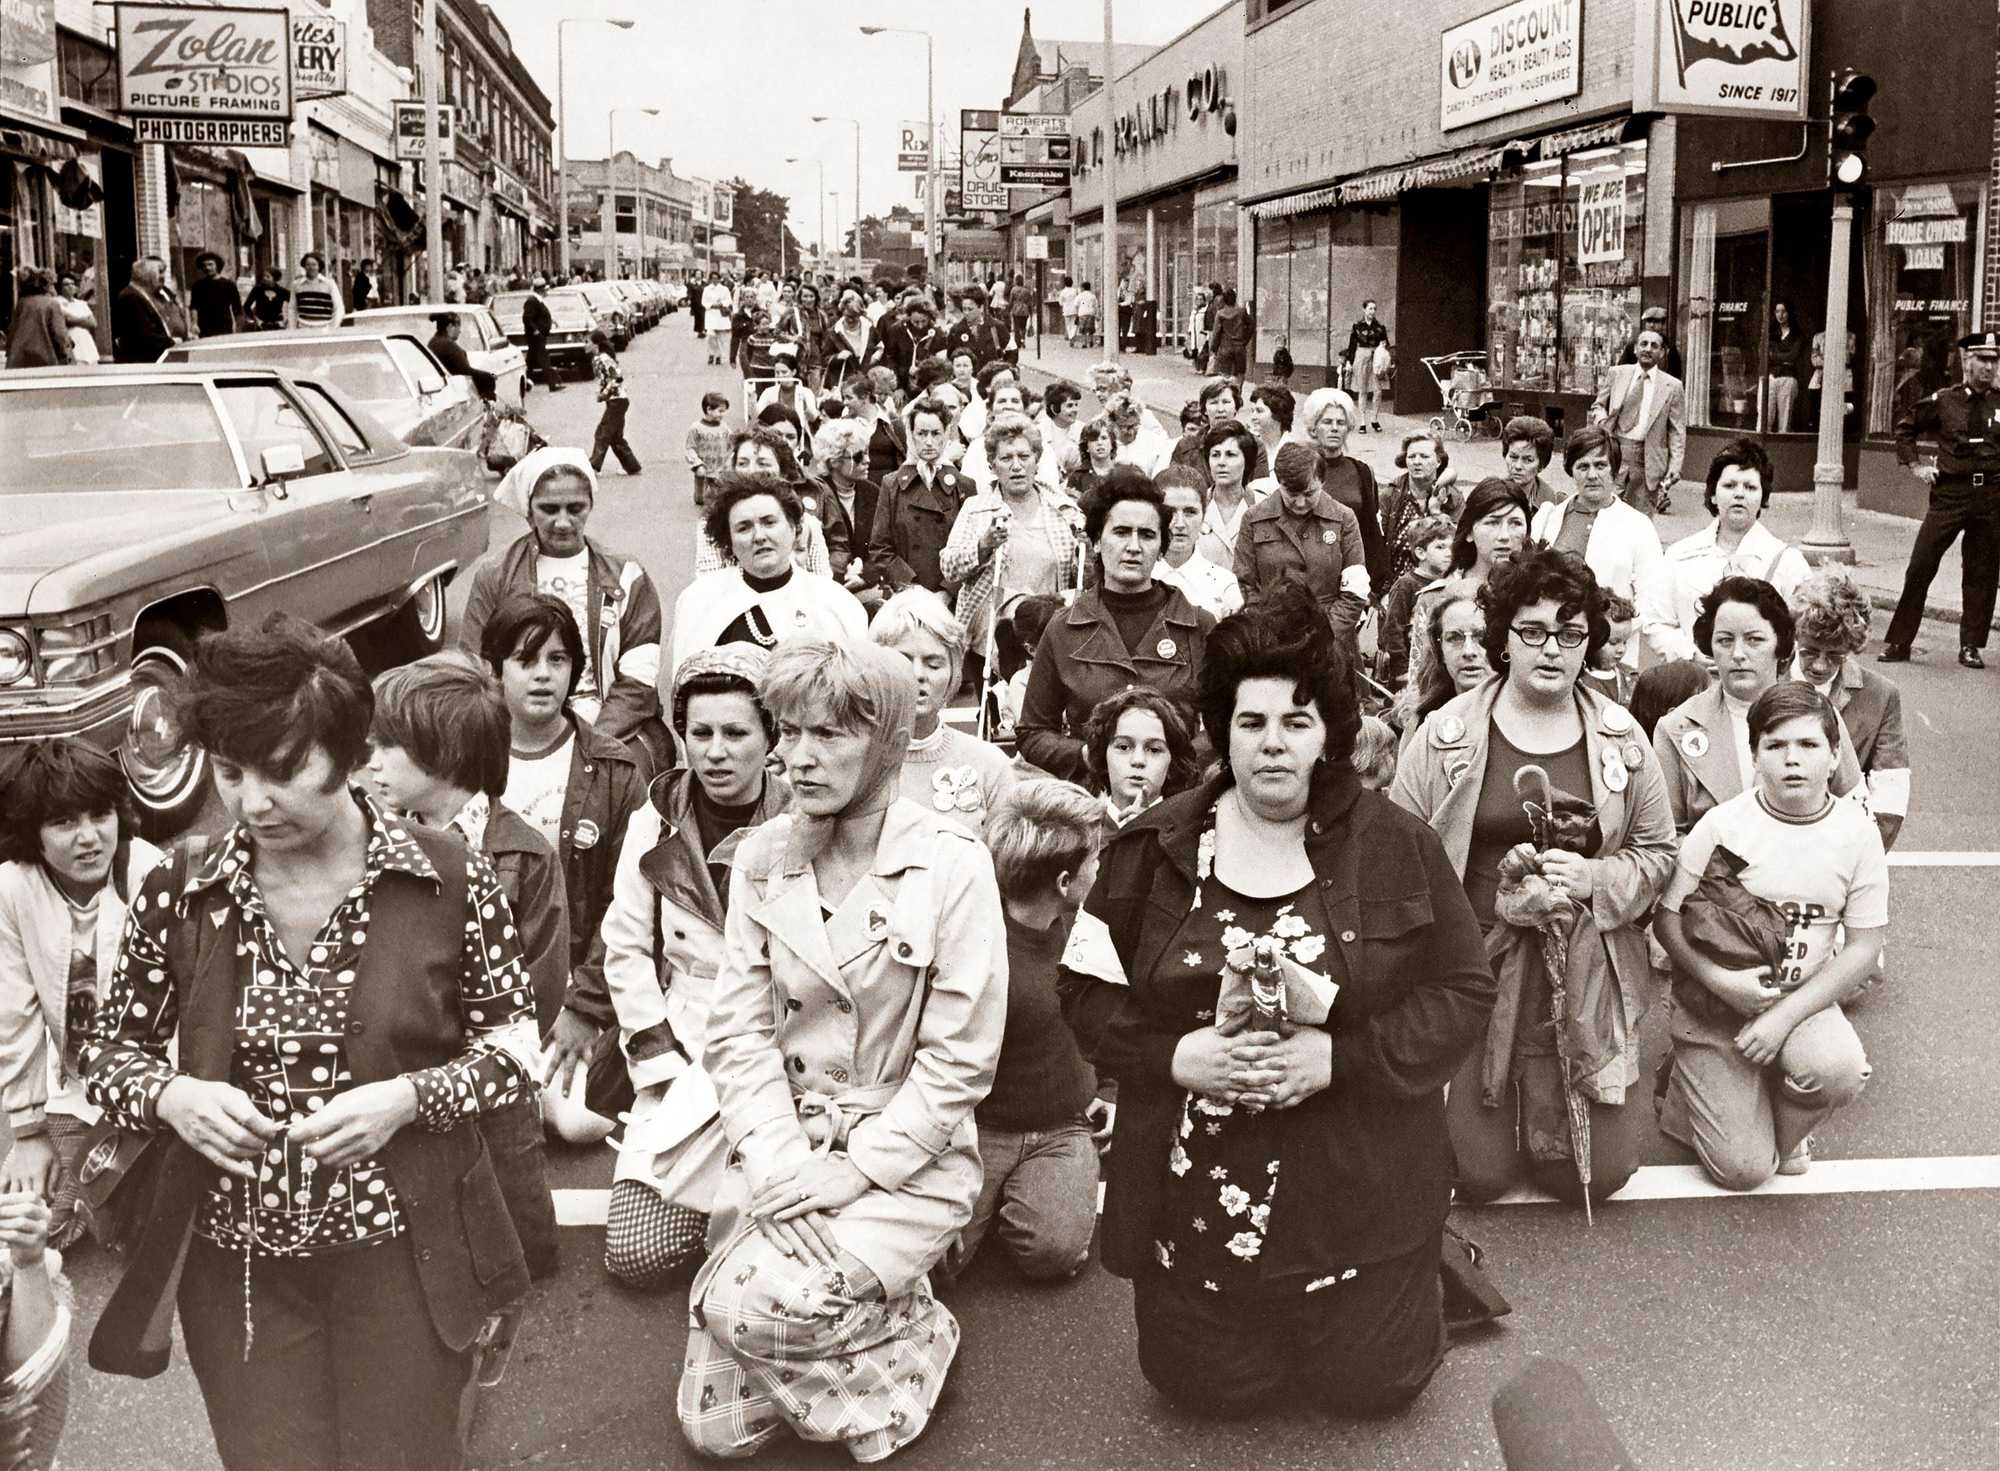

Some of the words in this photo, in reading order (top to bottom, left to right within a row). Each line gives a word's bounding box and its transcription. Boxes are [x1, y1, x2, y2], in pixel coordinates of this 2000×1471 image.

[1688, 1, 1767, 30] PUBLIC
[1490, 0, 1572, 58] DISCOUNT
[127, 18, 279, 77] Zolan
[1489, 60, 1515, 81] HEALTH
[1524, 48, 1550, 71] BEAUTY
[1554, 39, 1572, 60] AIDS
[1472, 86, 1513, 107] STATIONERY
[1520, 67, 1571, 90] HOUSEWARES
[1718, 84, 1763, 100] SINCE
[1770, 88, 1798, 102] 1917
[130, 93, 200, 108] PICTURE
[209, 97, 281, 111] FRAMING
[138, 119, 283, 143] PHOTOGRAPHERS
[1006, 117, 1066, 127] ROBERTS
[967, 181, 1004, 193] DRUG
[1584, 183, 1600, 204] WE
[1602, 180, 1624, 201] ARE
[964, 194, 1007, 206] STORE
[1582, 204, 1622, 255] OPEN
[1889, 221, 1924, 244] HOME
[1719, 302, 1748, 312] FINANCE
[1894, 300, 1926, 311] PUBLIC
[1929, 300, 1969, 311] FINANCE
